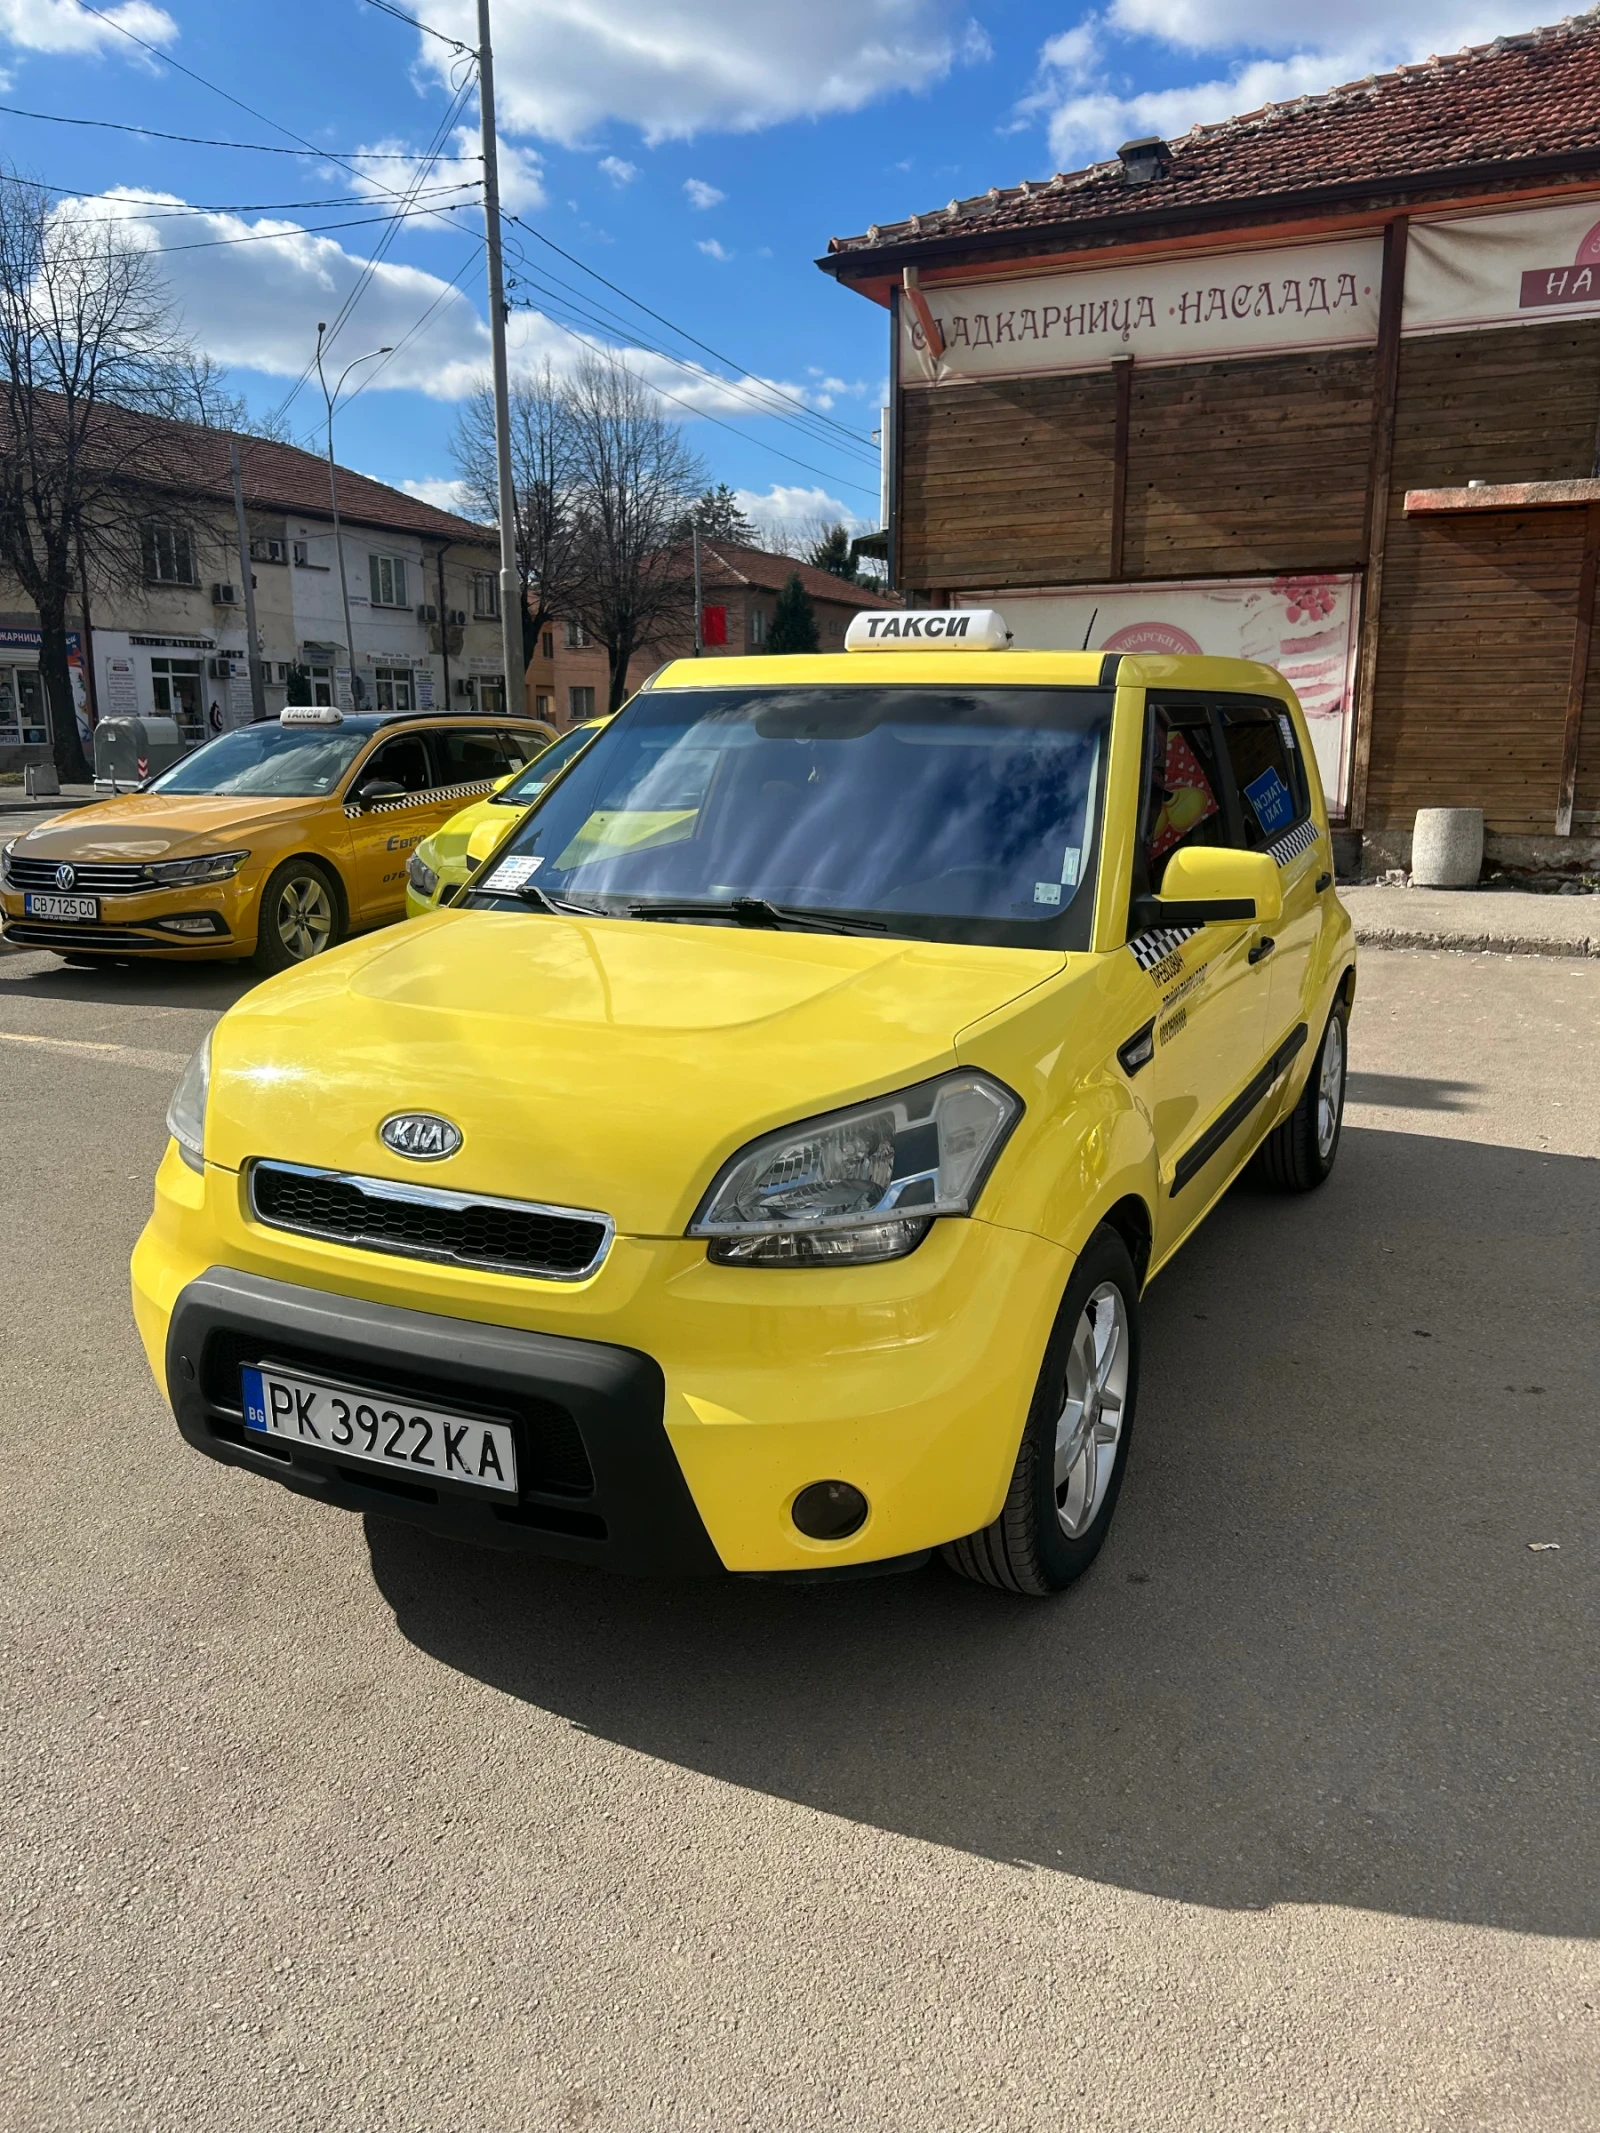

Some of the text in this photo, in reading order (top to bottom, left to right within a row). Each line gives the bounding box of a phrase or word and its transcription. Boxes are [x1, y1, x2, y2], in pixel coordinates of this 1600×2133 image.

[867, 617, 970, 638] ТАКСИ
[287, 709, 322, 719] ТАКСИ
[393, 1120, 443, 1150] KIA
[249, 1406, 264, 1423] BG
